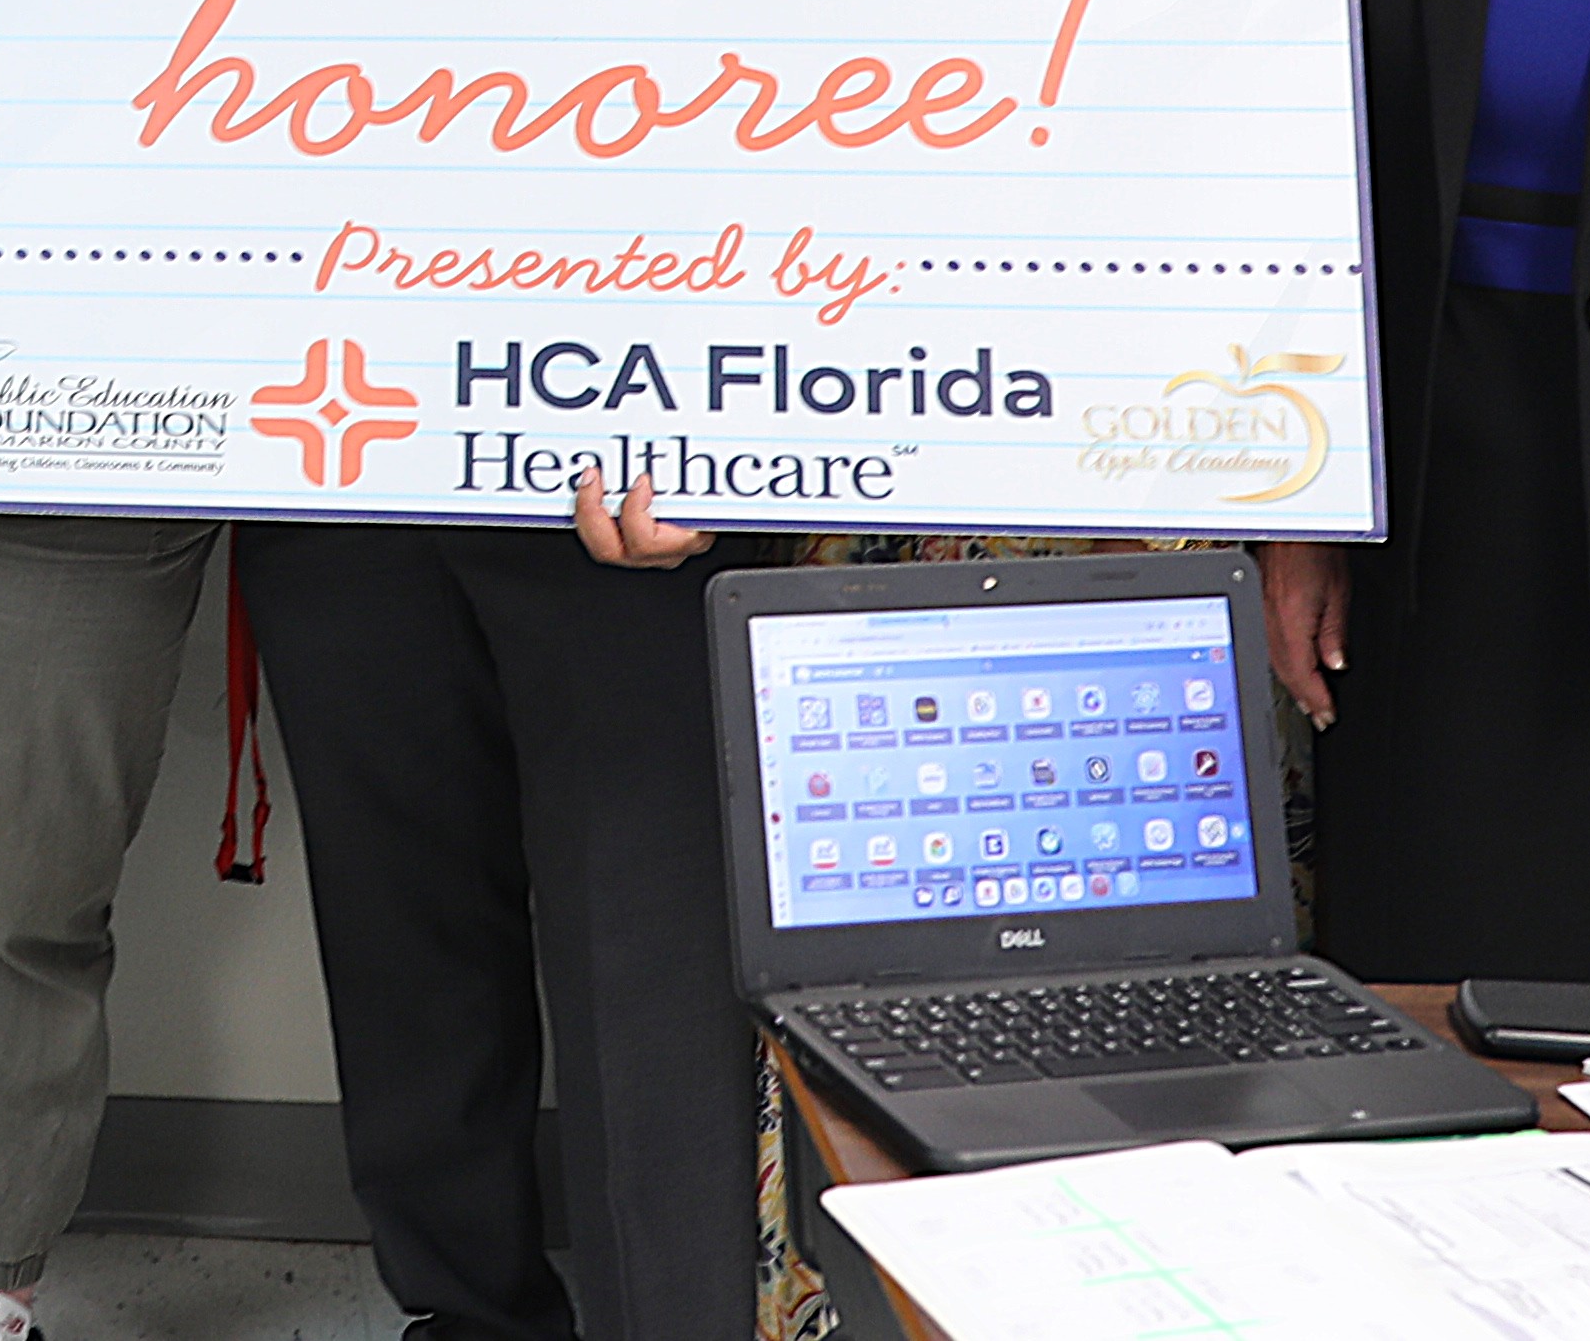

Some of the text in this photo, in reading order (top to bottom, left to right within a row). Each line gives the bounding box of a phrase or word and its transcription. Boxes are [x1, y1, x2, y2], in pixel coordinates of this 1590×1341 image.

[315, 221, 906, 328] Presented by:
[59, 374, 239, 410] Education
[453, 339, 1054, 421] HCA Florida
[1081, 404, 1287, 443] GOLDEN
[112, 437, 227, 451] COUNTY
[74, 458, 141, 471] Classrooms
[157, 459, 225, 476] Community
[453, 430, 894, 501] Healthcare
[1077, 445, 1290, 484] Apple Academy
